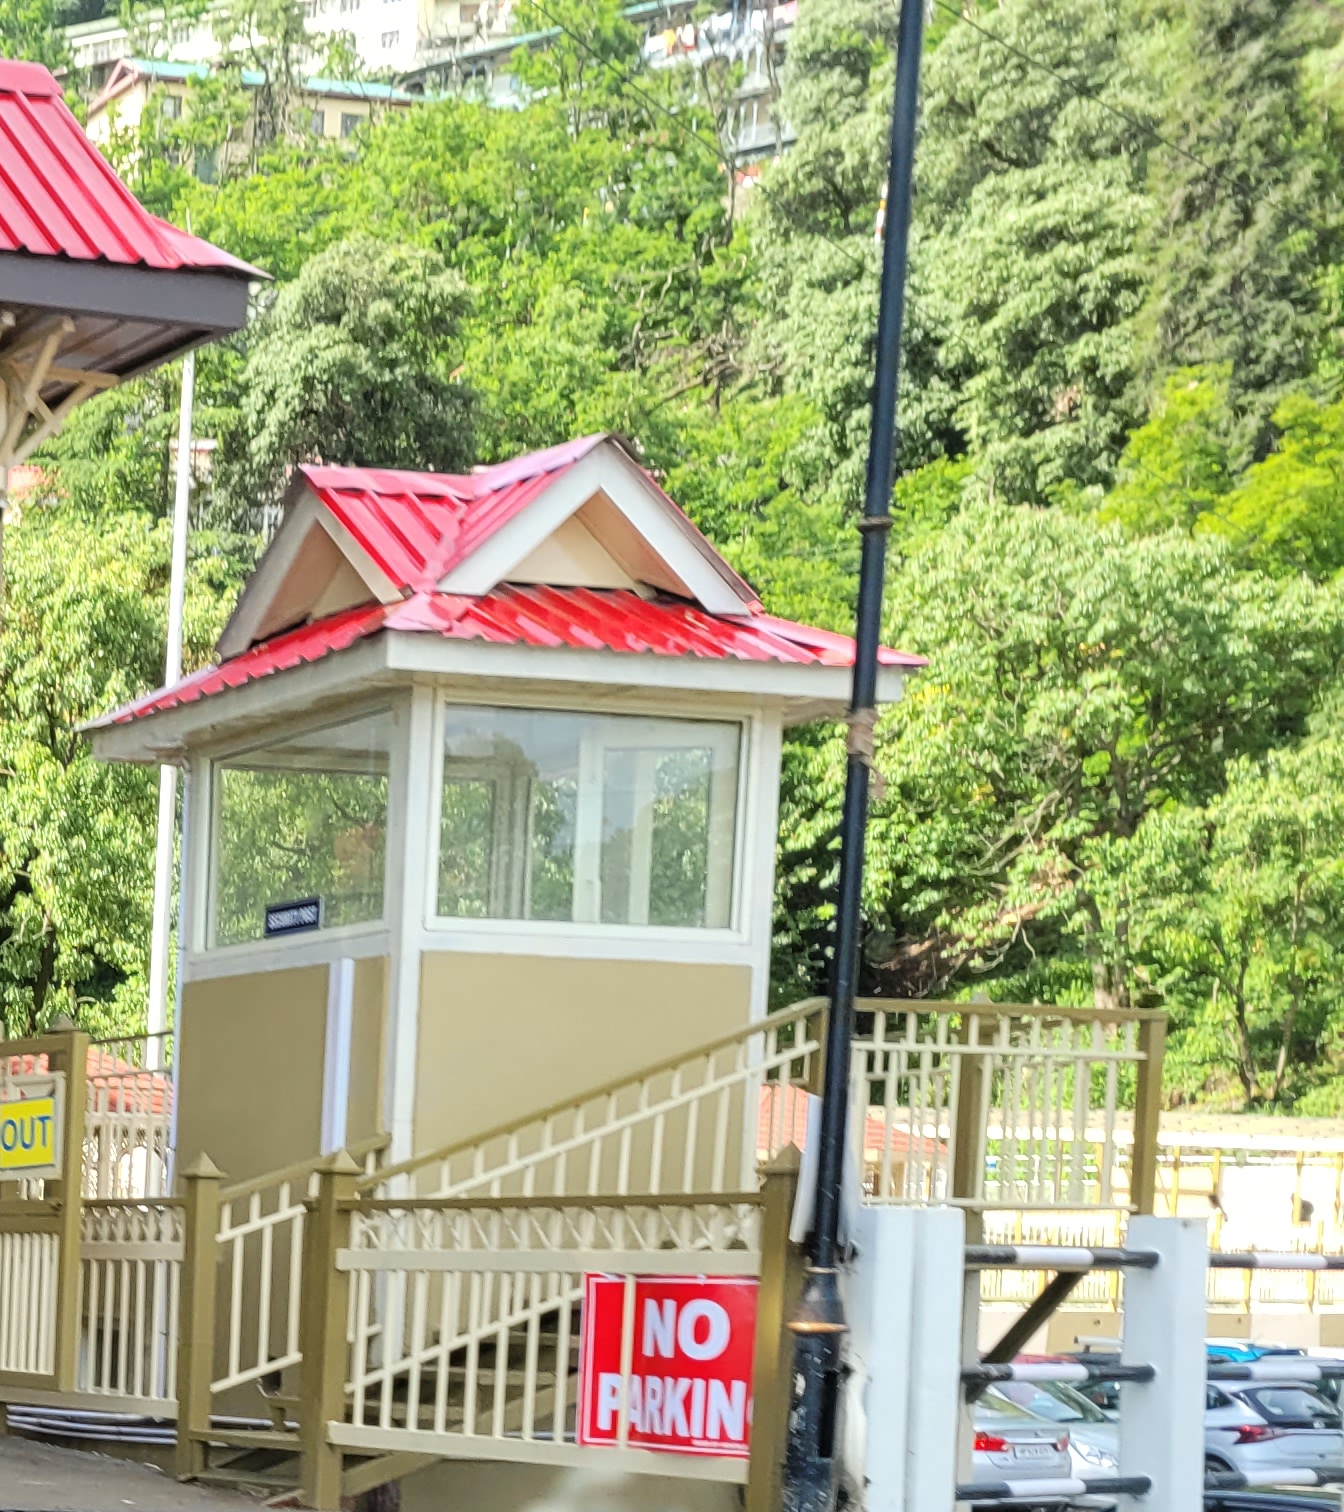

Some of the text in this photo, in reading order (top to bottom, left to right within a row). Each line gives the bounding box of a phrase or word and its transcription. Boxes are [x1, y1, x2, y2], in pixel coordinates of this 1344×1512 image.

[1, 1115, 51, 1151] OUT
[642, 1298, 731, 1361] NO
[597, 1372, 753, 1441] PARKIN
